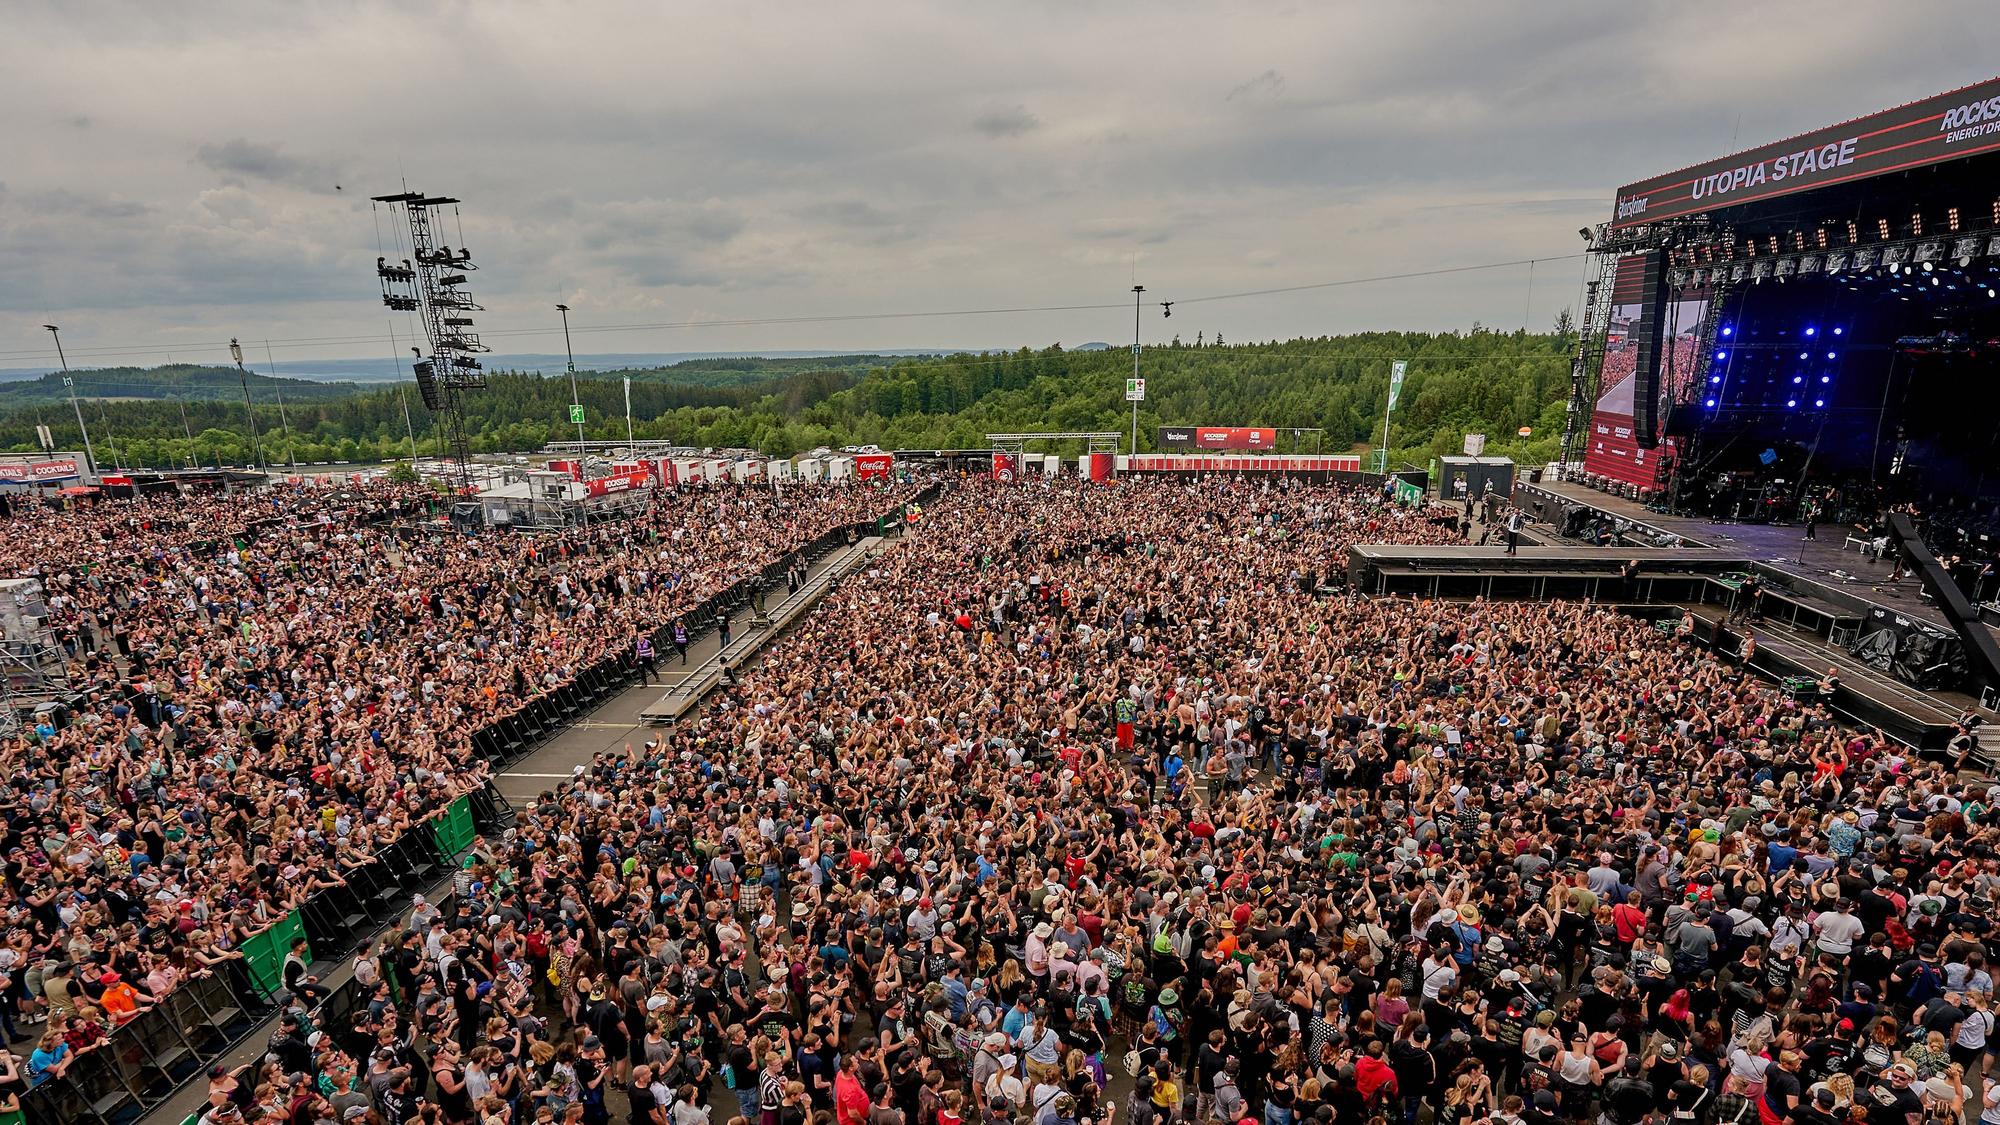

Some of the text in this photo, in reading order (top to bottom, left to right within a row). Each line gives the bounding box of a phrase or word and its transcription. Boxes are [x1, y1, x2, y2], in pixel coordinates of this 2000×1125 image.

[1940, 96, 2000, 131] ROCKS
[1946, 124, 1986, 144] ENERGY
[1691, 138, 1859, 200] UTOPIA STAGE
[36, 465, 75, 475] COCKTAILS
[860, 461, 886, 470] Coca-Cola
